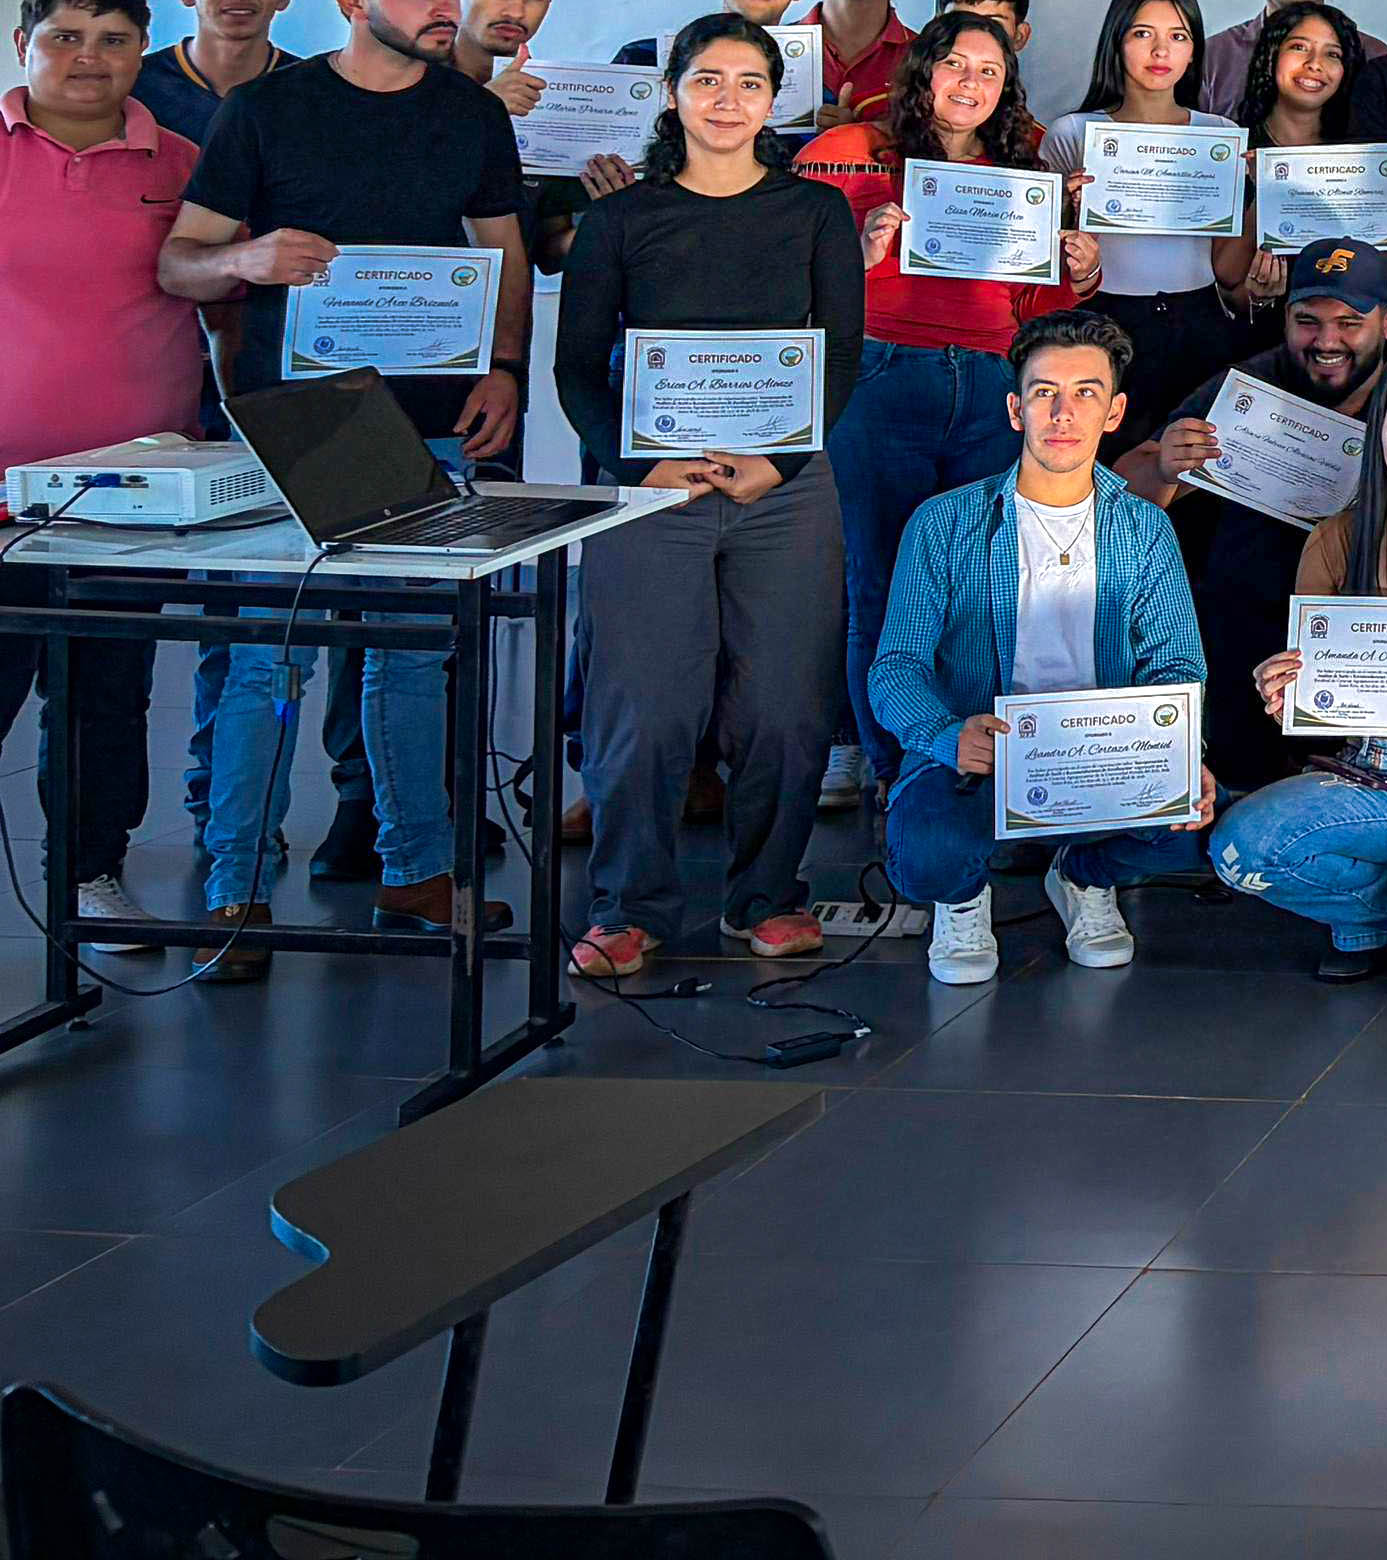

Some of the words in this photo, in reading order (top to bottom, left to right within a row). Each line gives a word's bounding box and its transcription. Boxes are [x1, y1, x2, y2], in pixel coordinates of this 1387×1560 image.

[549, 81, 615, 94] CERTIFICADO
[1137, 145, 1197, 157] CERTIFICADO
[1307, 165, 1366, 175] CERTIFICADO
[955, 184, 1013, 198] CERTIFICADO
[355, 270, 433, 281] CERTIFICADO
[688, 353, 762, 364] CERTIFICADO
[1269, 412, 1330, 441] CERTIFICADO
[1060, 714, 1136, 729] CERTIFICADO
